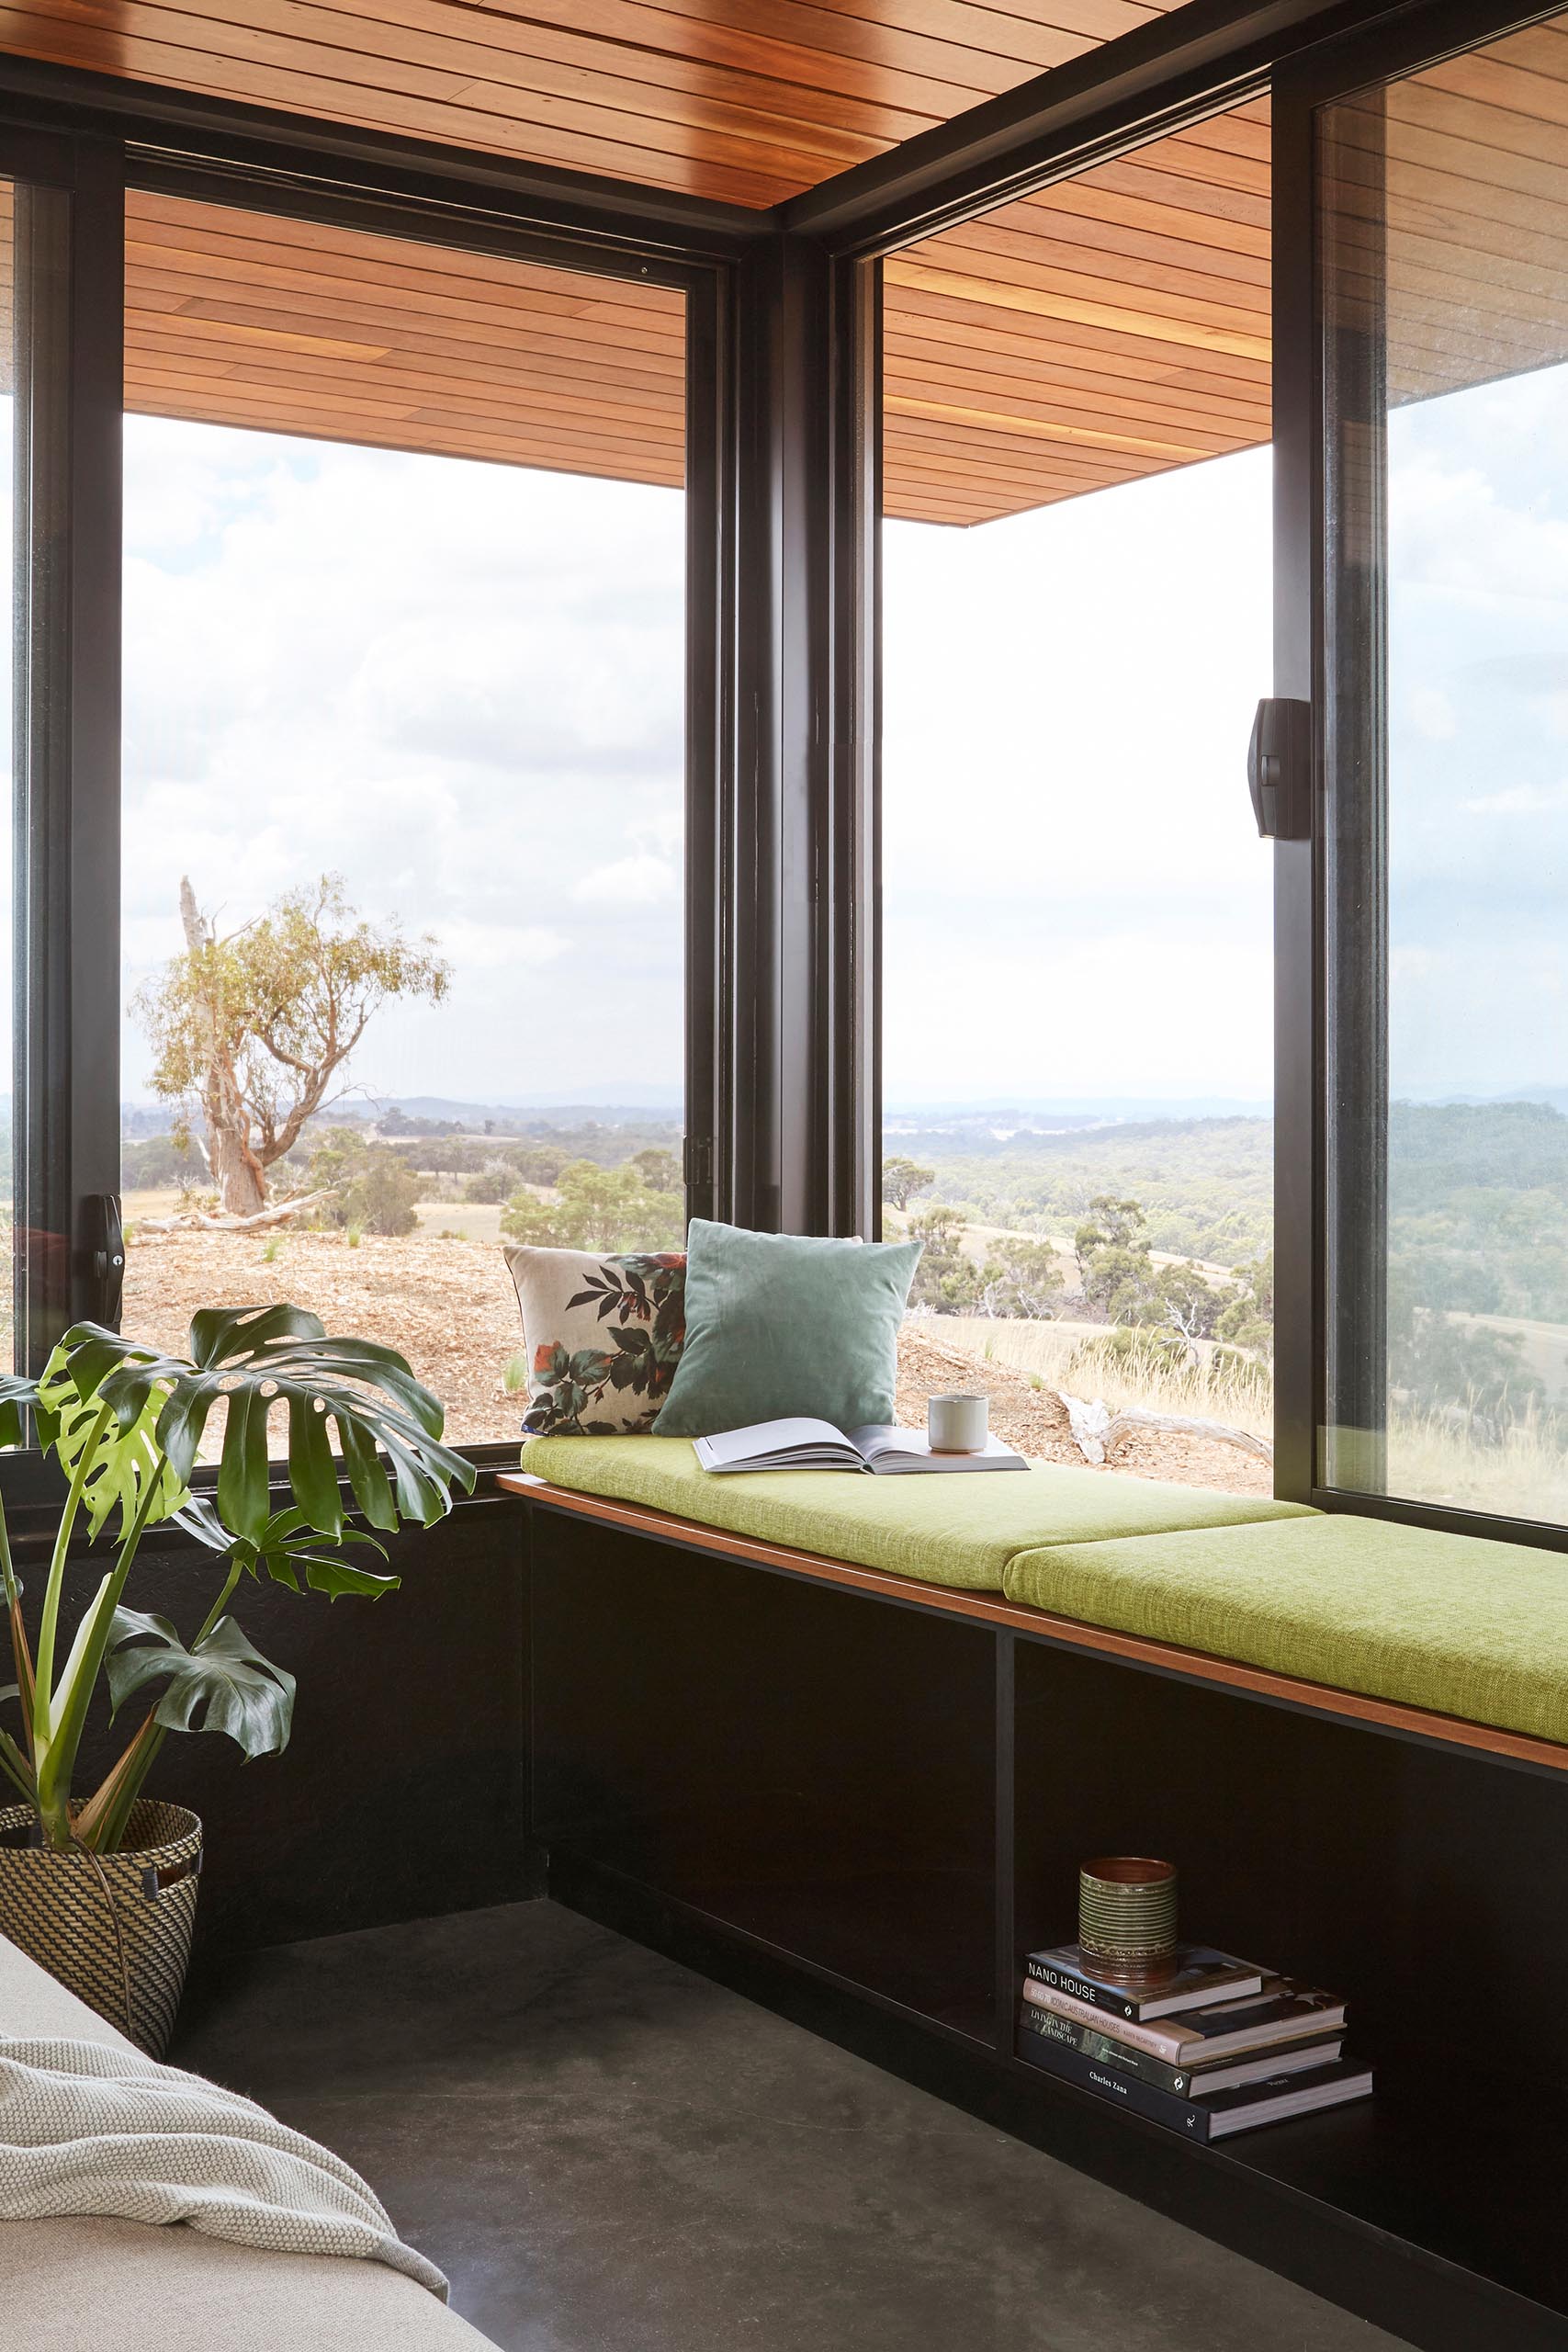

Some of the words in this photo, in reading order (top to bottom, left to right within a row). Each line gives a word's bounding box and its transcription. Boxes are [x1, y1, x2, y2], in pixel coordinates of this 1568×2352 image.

[1029, 1962, 1057, 1984] NANO
[1060, 1975, 1096, 2002] HOUSE
[1031, 2009, 1052, 2025] LIVING
[1052, 2018, 1058, 2029] IN
[1059, 2021, 1072, 2034] THE
[1067, 2005, 1099, 2025] AUSTRALIAN
[1100, 2018, 1120, 2033] HOUSES
[1042, 2024, 1077, 2046] LANDSCAPE
[1089, 2071, 1111, 2086] Charles
[1112, 2081, 1127, 2095] Zana
